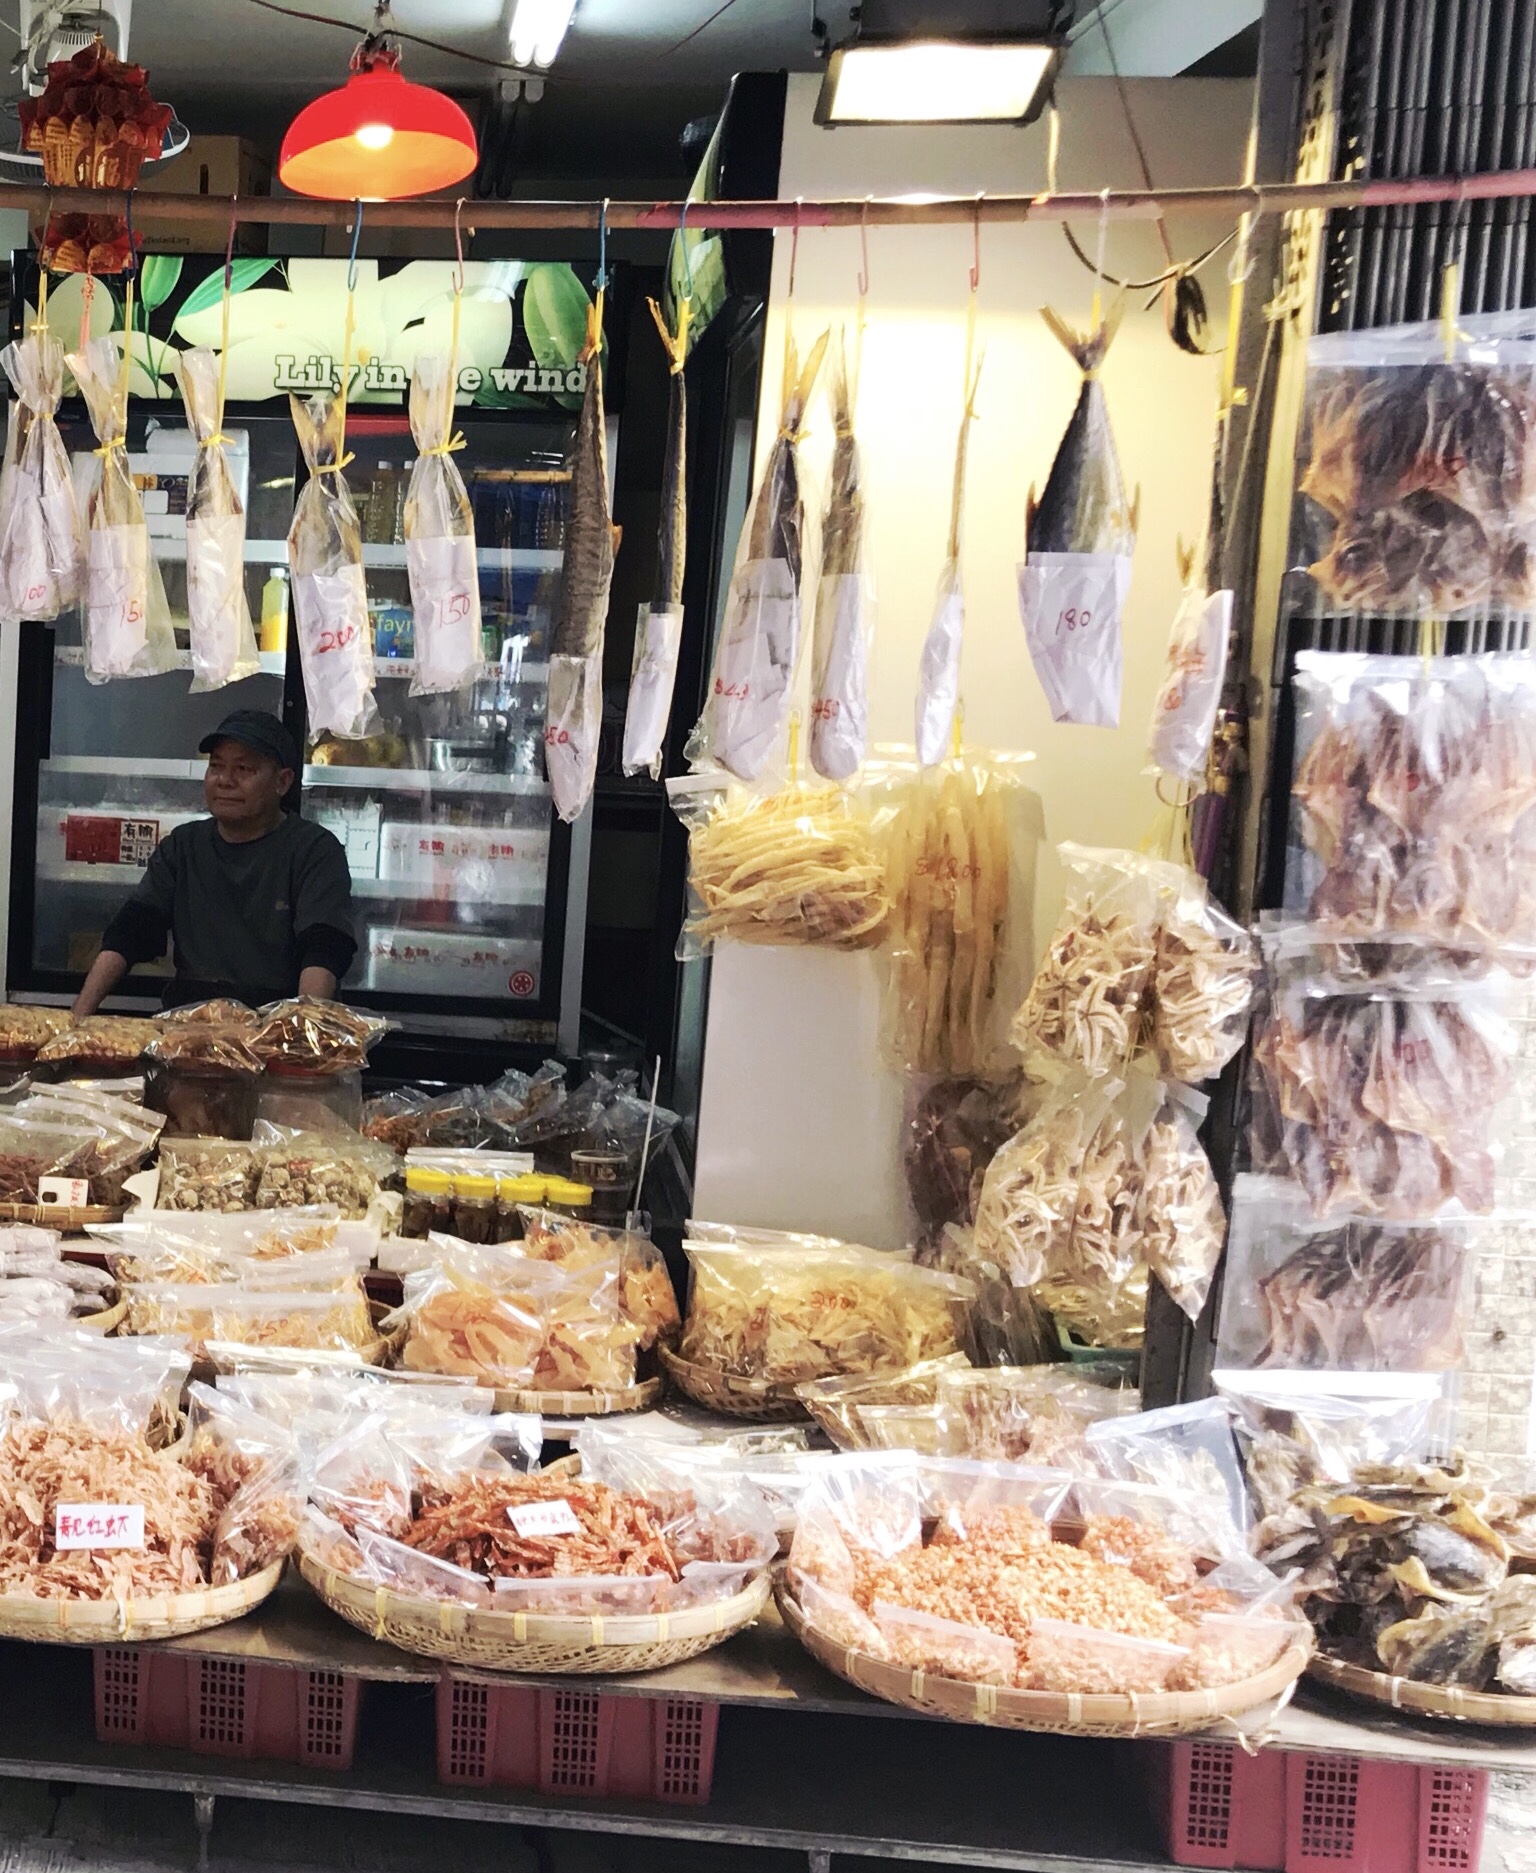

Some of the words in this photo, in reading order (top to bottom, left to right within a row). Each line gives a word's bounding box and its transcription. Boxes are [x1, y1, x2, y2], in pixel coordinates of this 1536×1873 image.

[274, 354, 360, 393] Lily
[365, 356, 407, 390] in
[490, 360, 587, 393] wind
[438, 593, 471, 629] 150
[1055, 608, 1091, 636] 180
